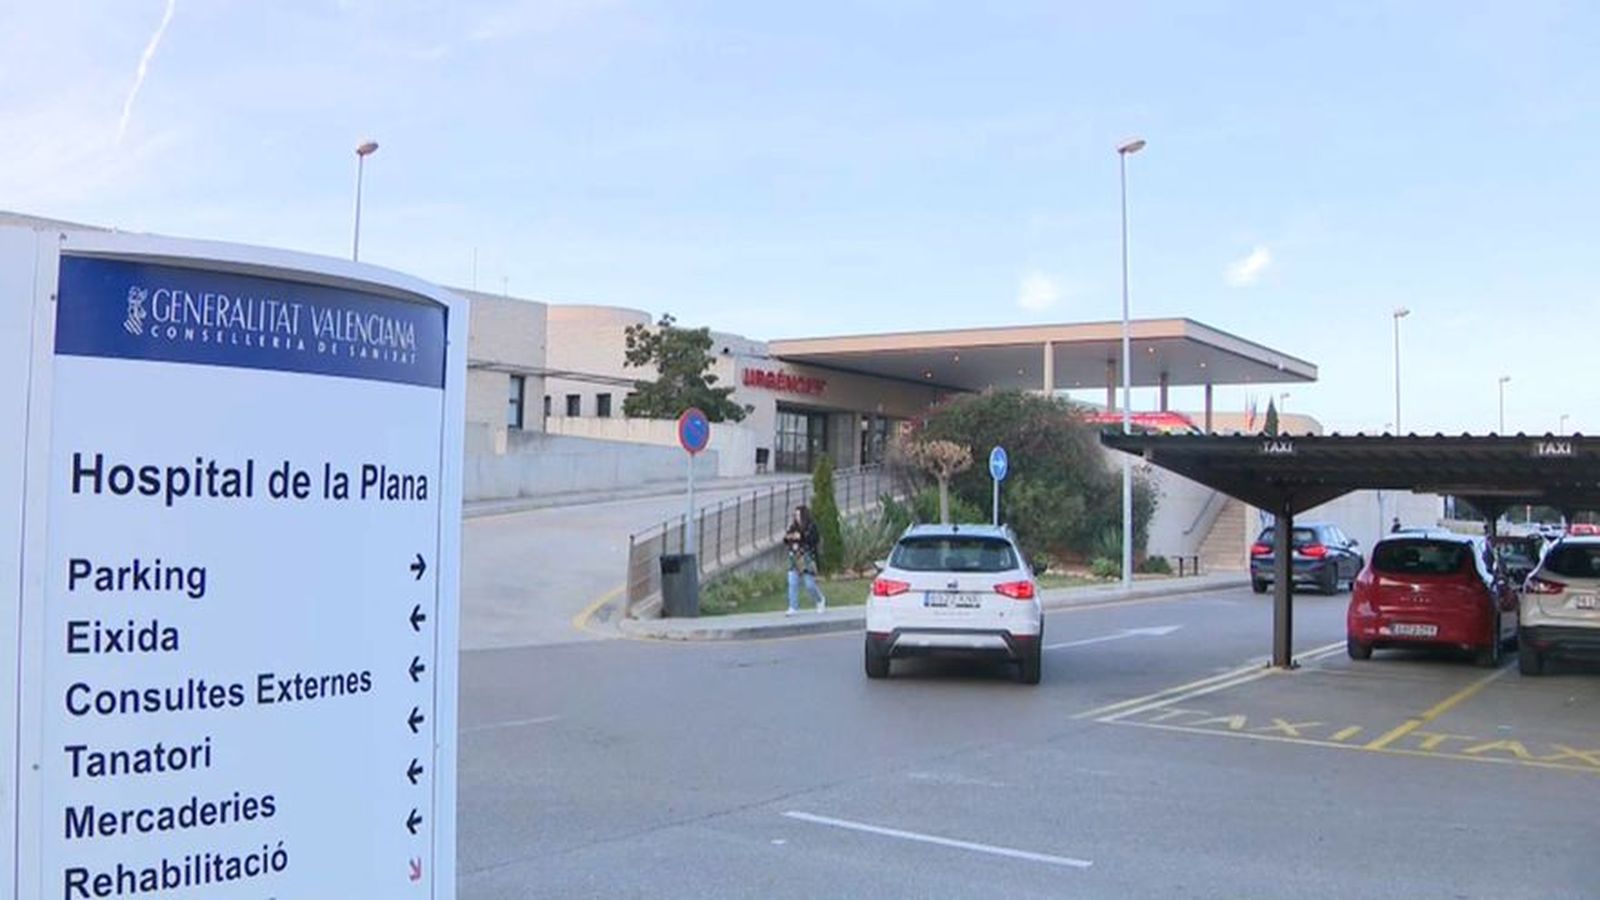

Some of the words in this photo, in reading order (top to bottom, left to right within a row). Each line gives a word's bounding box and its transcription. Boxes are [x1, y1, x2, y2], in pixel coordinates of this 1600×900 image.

[151, 287, 302, 336] GENERALITAT
[310, 304, 417, 351] VALENCIANA
[150, 324, 305, 351] CONSELLERIA
[317, 340, 338, 356] DE
[1263, 440, 1293, 453] TAXI
[1537, 442, 1571, 455] TAXI
[72, 452, 254, 507] Hospital
[268, 460, 311, 500] de
[323, 462, 349, 501] la
[360, 463, 428, 501] Plana
[68, 558, 206, 599] Parking
[67, 619, 179, 654] Eixida
[65, 678, 245, 717] Consultes
[257, 670, 372, 705] Externes
[1147, 706, 1365, 742] TAXI
[64, 736, 211, 778] Tanatori
[65, 791, 276, 840] Mercaderies
[64, 840, 288, 900] Rehabilitació
